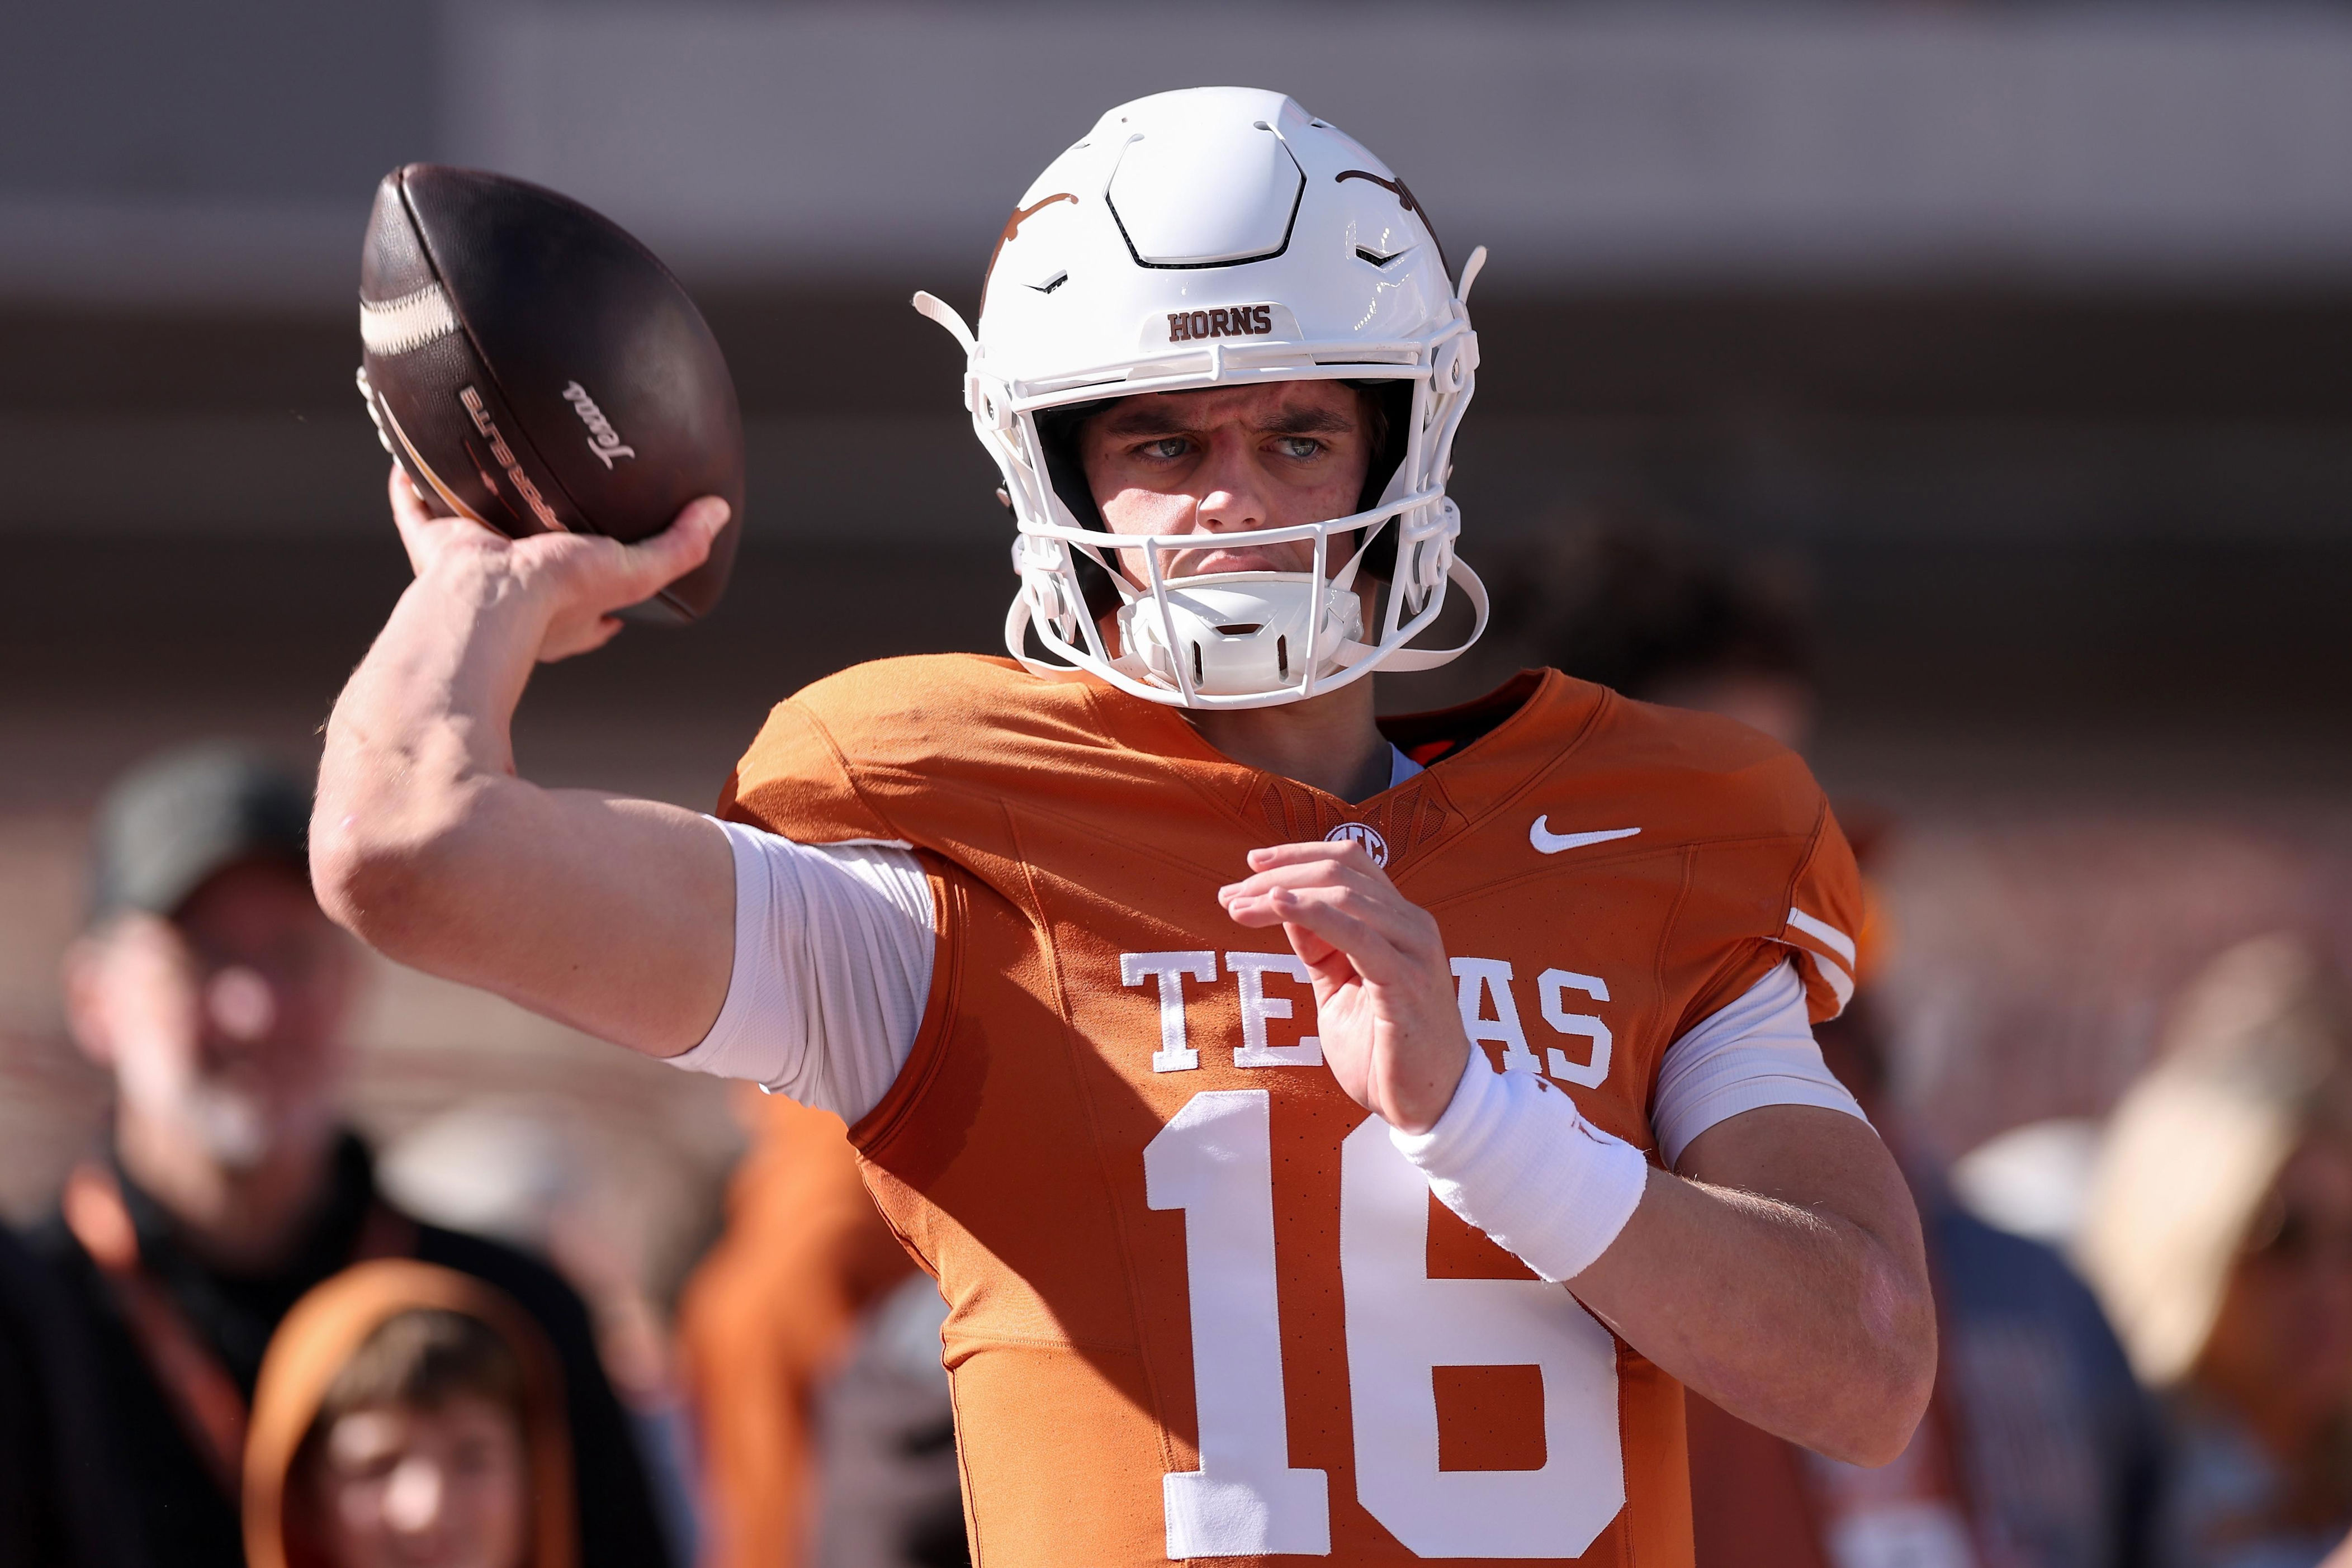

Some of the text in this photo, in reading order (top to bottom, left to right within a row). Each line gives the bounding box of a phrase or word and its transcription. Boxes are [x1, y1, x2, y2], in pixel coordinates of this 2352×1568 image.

[1167, 305, 1272, 343] HORNS
[460, 385, 517, 469] ELITE
[562, 380, 636, 470] Texas
[1120, 950, 1612, 1089] TEAS
[1142, 1089, 1627, 1560] 16
